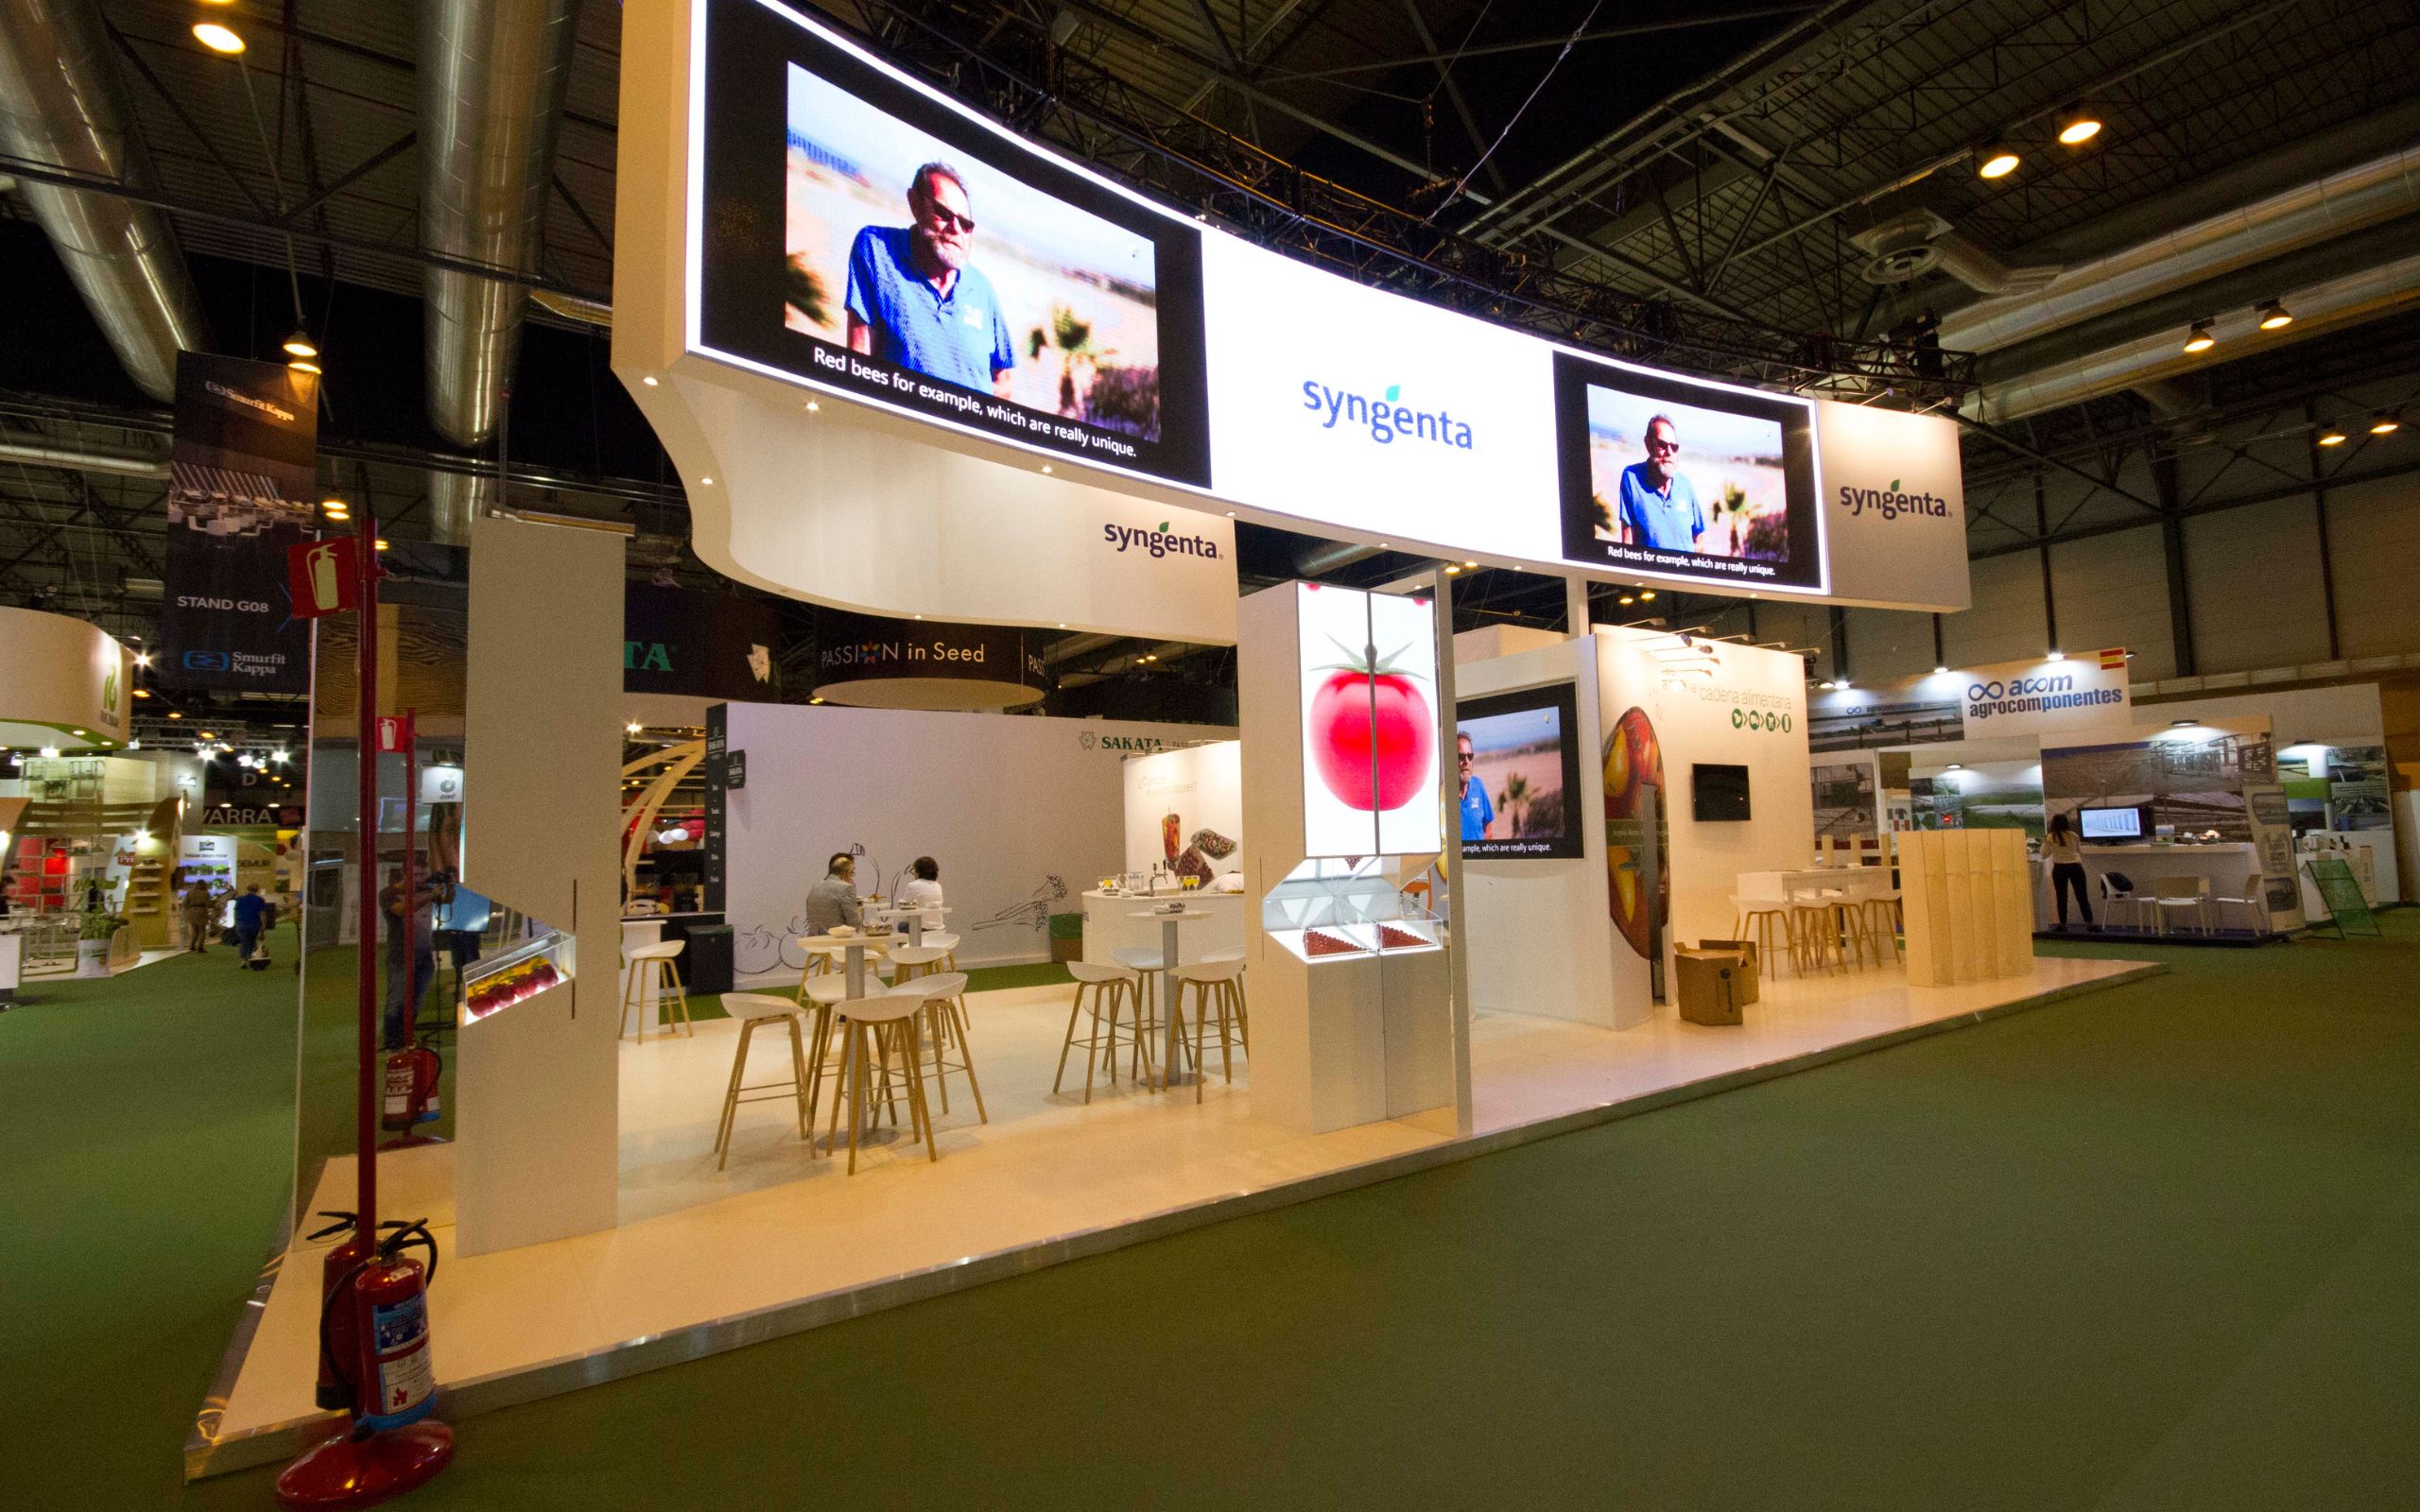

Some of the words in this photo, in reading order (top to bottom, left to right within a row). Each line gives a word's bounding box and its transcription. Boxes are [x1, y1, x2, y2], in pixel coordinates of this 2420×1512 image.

[815, 346, 846, 372] Red
[852, 358, 889, 386] bees
[892, 372, 916, 393] for
[919, 384, 983, 416] example,
[987, 404, 1026, 427] which
[1029, 418, 1051, 435] are
[1055, 425, 1089, 447] really
[1092, 435, 1137, 457] unique.
[1303, 380, 1473, 450] syngenta
[1840, 486, 1946, 521] syngenta
[1104, 524, 1218, 559] syngenta
[1608, 545, 1623, 558] Red
[1623, 549, 1642, 561] bees
[1643, 551, 1655, 562] for
[1656, 554, 1690, 568] example,
[1690, 557, 1713, 569] which
[1714, 561, 1727, 571] are
[1727, 562, 1748, 575] really
[1748, 565, 1776, 577] unique.
[177, 595, 233, 610] STAND
[237, 600, 269, 613] G08
[233, 651, 286, 664] Smurfit
[908, 643, 925, 660] in
[933, 642, 984, 662] Seed
[233, 662, 276, 676] Kappa
[1969, 688, 2123, 718] agrocomponentes
[1481, 843, 1499, 851] which
[1511, 843, 1528, 853] really
[1528, 842, 1551, 853] unique.
